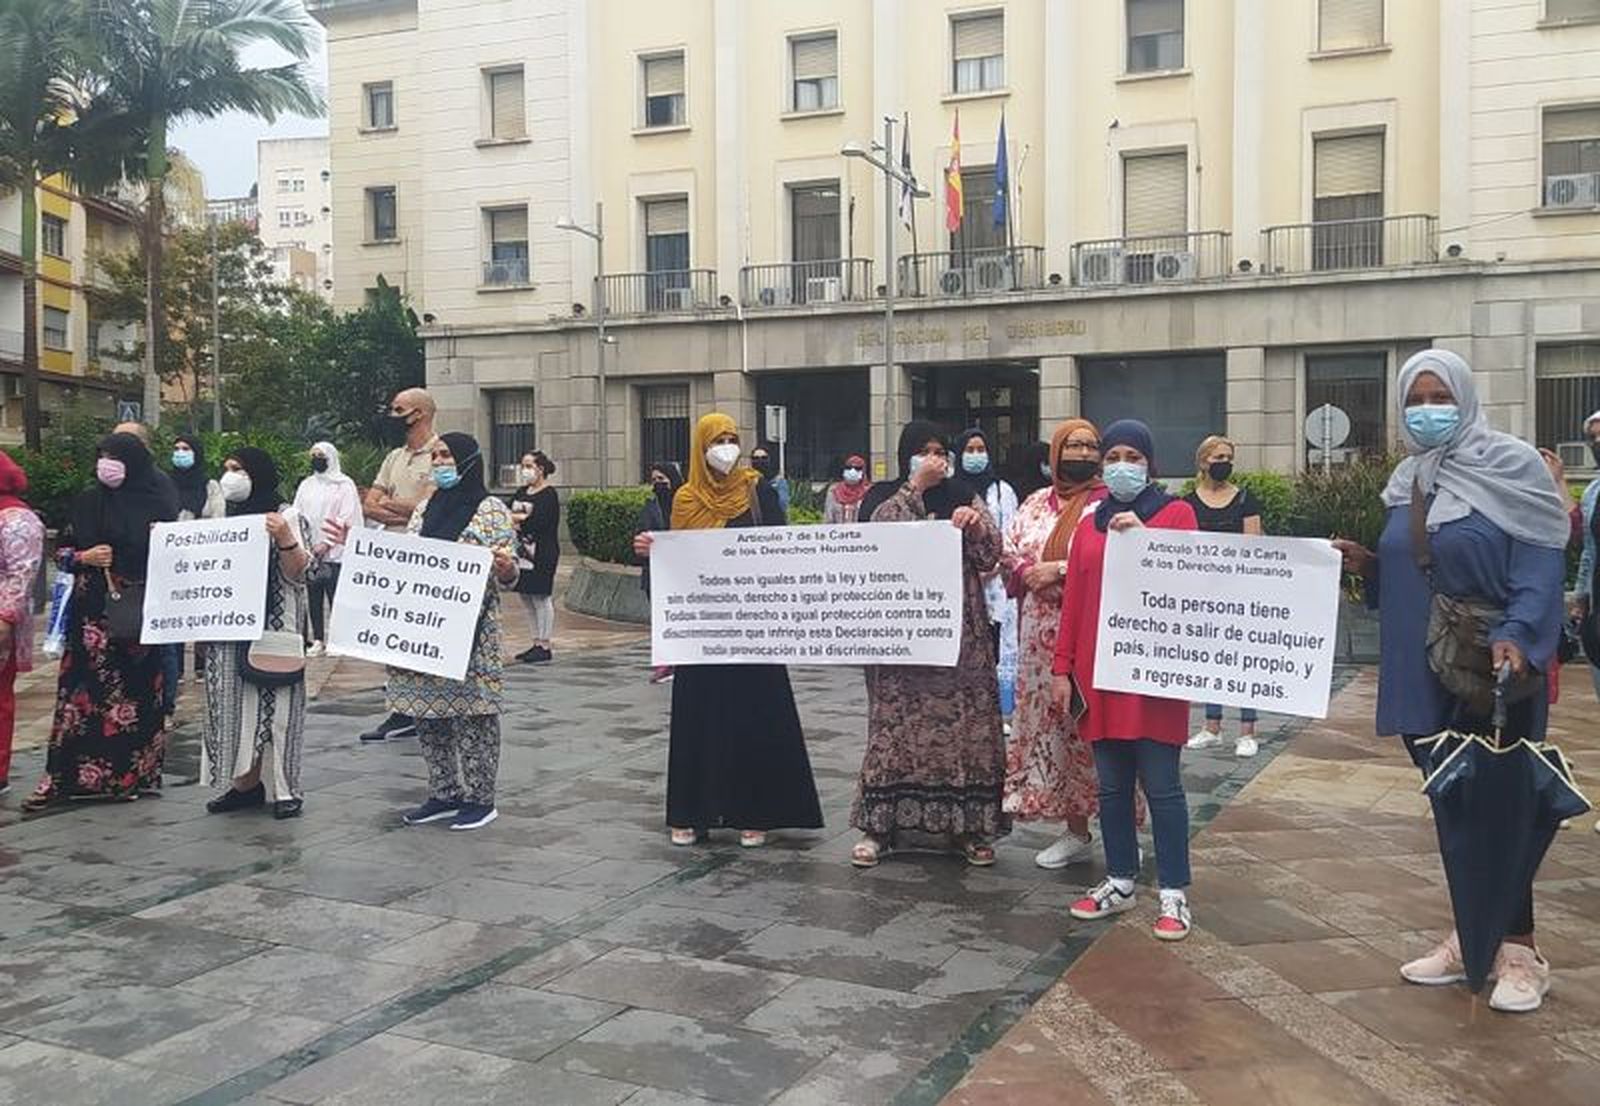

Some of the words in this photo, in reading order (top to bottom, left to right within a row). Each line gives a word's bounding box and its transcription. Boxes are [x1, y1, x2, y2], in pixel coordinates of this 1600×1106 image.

[165, 527, 249, 548] Posibilidad
[786, 531, 793, 541] 7
[797, 532, 811, 541] de
[815, 531, 826, 540] la
[829, 529, 862, 540] Carta
[354, 540, 450, 570] Llevamos
[457, 560, 481, 575] un
[722, 547, 737, 557] de
[739, 547, 757, 556] los
[760, 545, 817, 555] Derechos
[820, 543, 879, 553] Humanos
[1196, 545, 1219, 557] 13/2
[1221, 547, 1237, 558] de
[1240, 547, 1251, 558] la
[1254, 548, 1287, 561] Carta
[174, 560, 189, 573] de
[193, 559, 218, 571] ver
[221, 559, 231, 570] a
[1140, 558, 1154, 568] de
[1157, 558, 1173, 569] los
[1177, 559, 1233, 574] Derechos
[1236, 563, 1293, 579] Humanos
[352, 570, 390, 589] año
[395, 580, 408, 595] y
[412, 582, 471, 604] medio
[698, 574, 731, 586] Todos
[733, 576, 755, 585] son
[757, 573, 796, 588] iguales
[800, 573, 823, 584] ante
[826, 572, 837, 583] la
[839, 571, 857, 586] ley
[859, 573, 867, 586] y
[869, 571, 908, 583] tienen,
[171, 585, 233, 600] nuestros
[667, 592, 684, 604] sin
[744, 591, 788, 603] derecho
[790, 592, 798, 602] a
[800, 591, 828, 604] igual
[831, 590, 893, 604] protección
[895, 589, 910, 601] de
[913, 588, 924, 600] la
[927, 588, 947, 603] ley.
[370, 602, 398, 620] sin
[404, 609, 446, 629] salir
[664, 610, 697, 622] Todos
[735, 608, 779, 621] derecho
[781, 610, 789, 620] a
[791, 609, 818, 623] igual
[821, 608, 883, 621] protección
[885, 609, 923, 619] contra
[925, 607, 951, 619] toda
[1141, 591, 1176, 610] Toda
[1181, 597, 1245, 617] persona
[1250, 602, 1291, 620] tiene
[150, 615, 184, 630] seres
[186, 610, 256, 629] queridos
[745, 628, 765, 640] que
[835, 626, 903, 639] Declaración
[905, 629, 914, 641] y
[916, 627, 953, 638] contra
[1108, 614, 1168, 635] derecho
[1172, 622, 1181, 635] a
[1186, 622, 1220, 640] salir
[1225, 624, 1243, 642] de
[1248, 629, 1325, 651] cualquier
[357, 629, 379, 645] de
[385, 633, 444, 660] Ceuta.
[730, 645, 797, 658] provocación
[800, 646, 806, 656] a
[809, 645, 823, 656] tal
[1113, 639, 1149, 658] país,
[1153, 641, 1209, 664] incluso
[1214, 648, 1238, 667] del
[1243, 655, 1299, 676] propio,
[1304, 662, 1314, 680] y
[1132, 666, 1140, 680] a
[1145, 669, 1209, 690] regresar
[1214, 676, 1223, 690] a
[1227, 677, 1246, 693] su
[1251, 679, 1289, 700] país.
